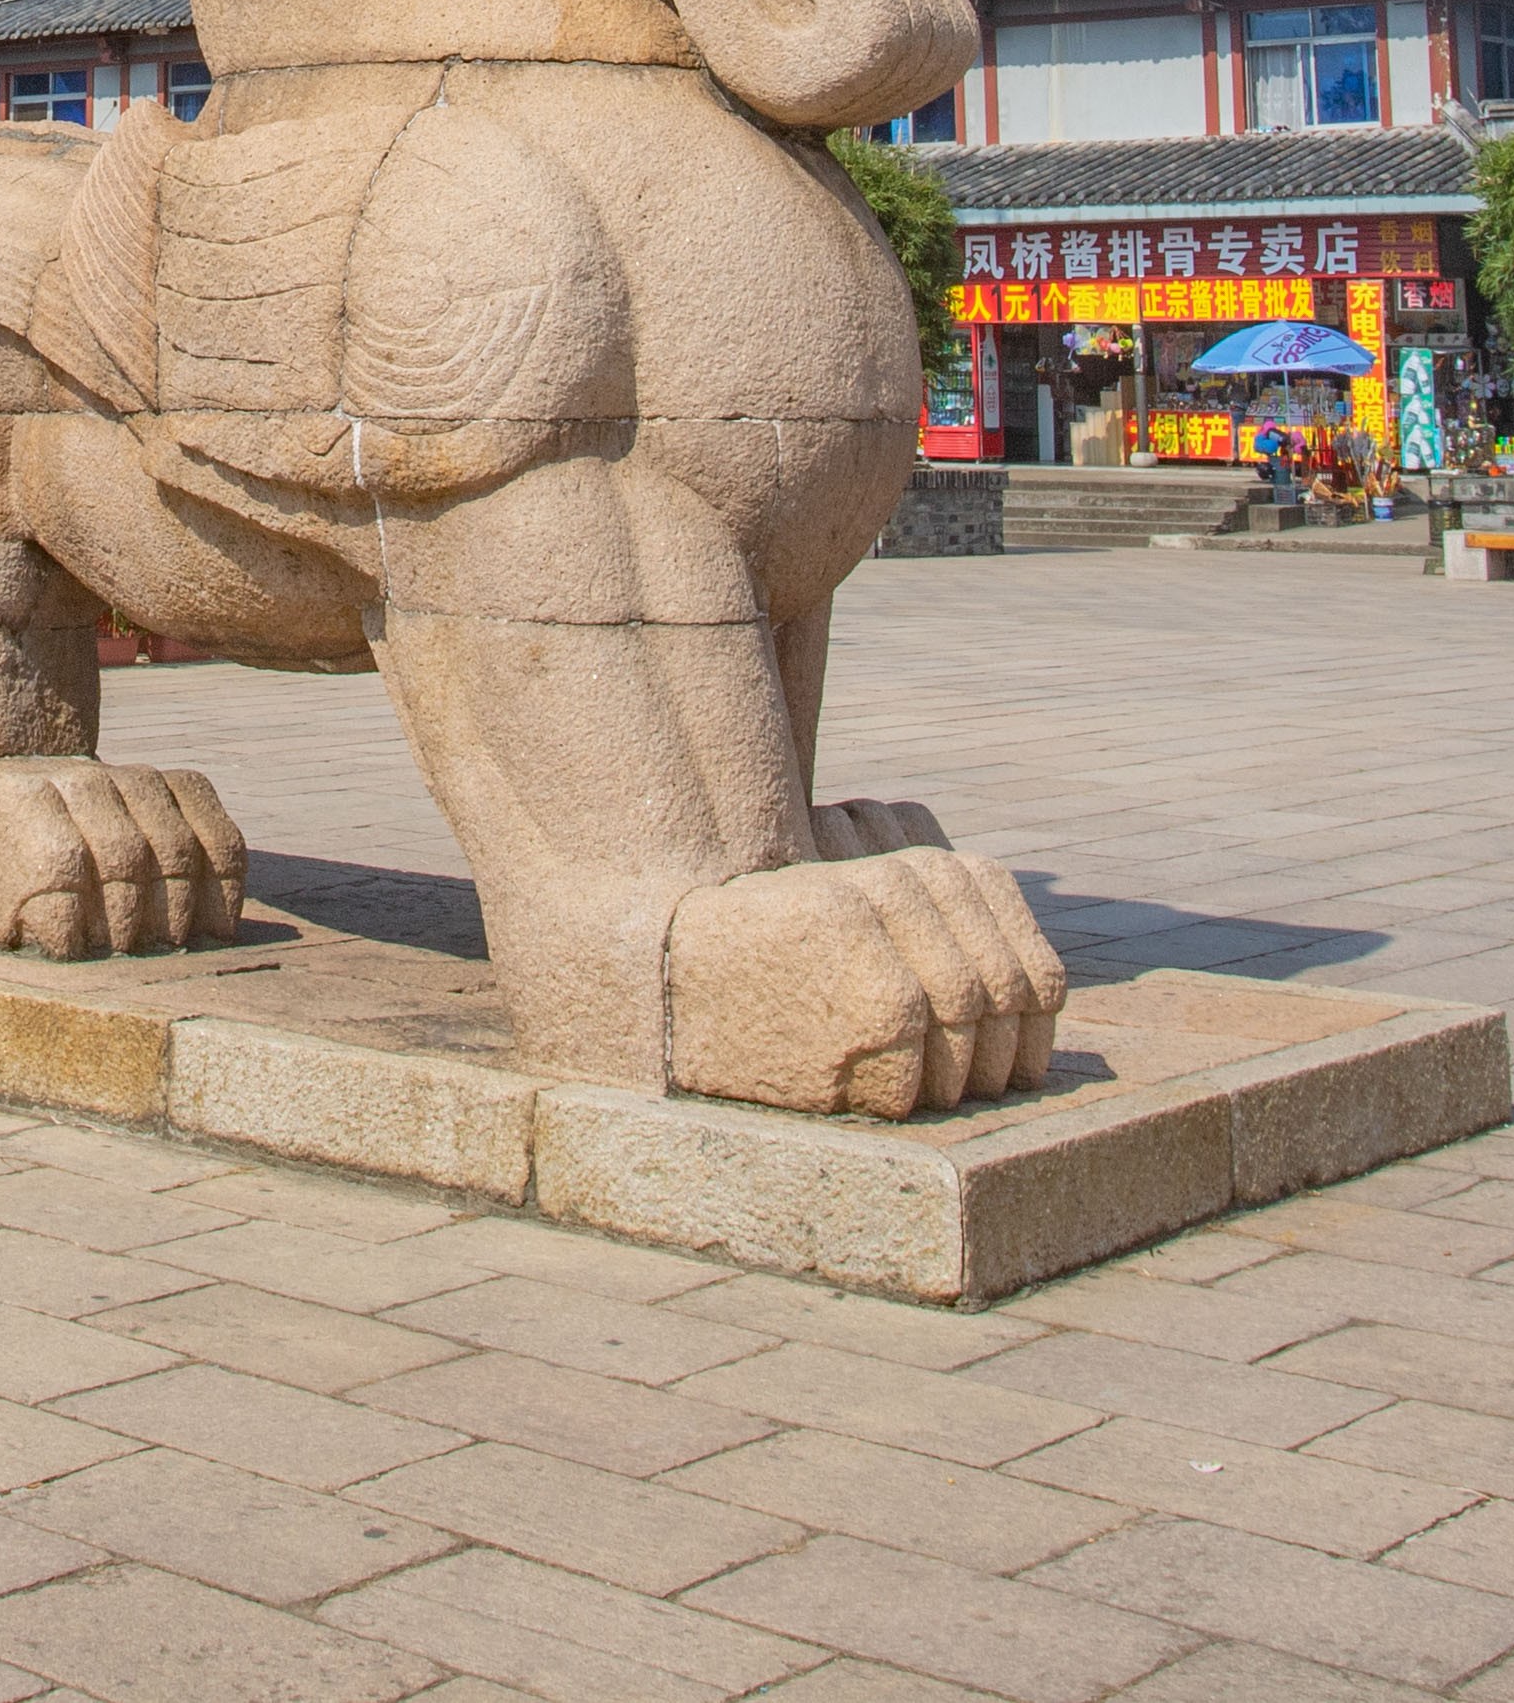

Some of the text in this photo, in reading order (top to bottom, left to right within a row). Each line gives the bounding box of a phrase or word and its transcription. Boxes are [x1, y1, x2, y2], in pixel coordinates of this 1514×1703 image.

[1379, 220, 1434, 242] 香烟
[963, 222, 1359, 280] 凤桥酱排骨专卖店
[1379, 250, 1437, 273] 饮料
[1069, 284, 1138, 321] 香烟
[1142, 278, 1314, 320] 正宗酱排骨批发
[1403, 281, 1454, 309] 香烟
